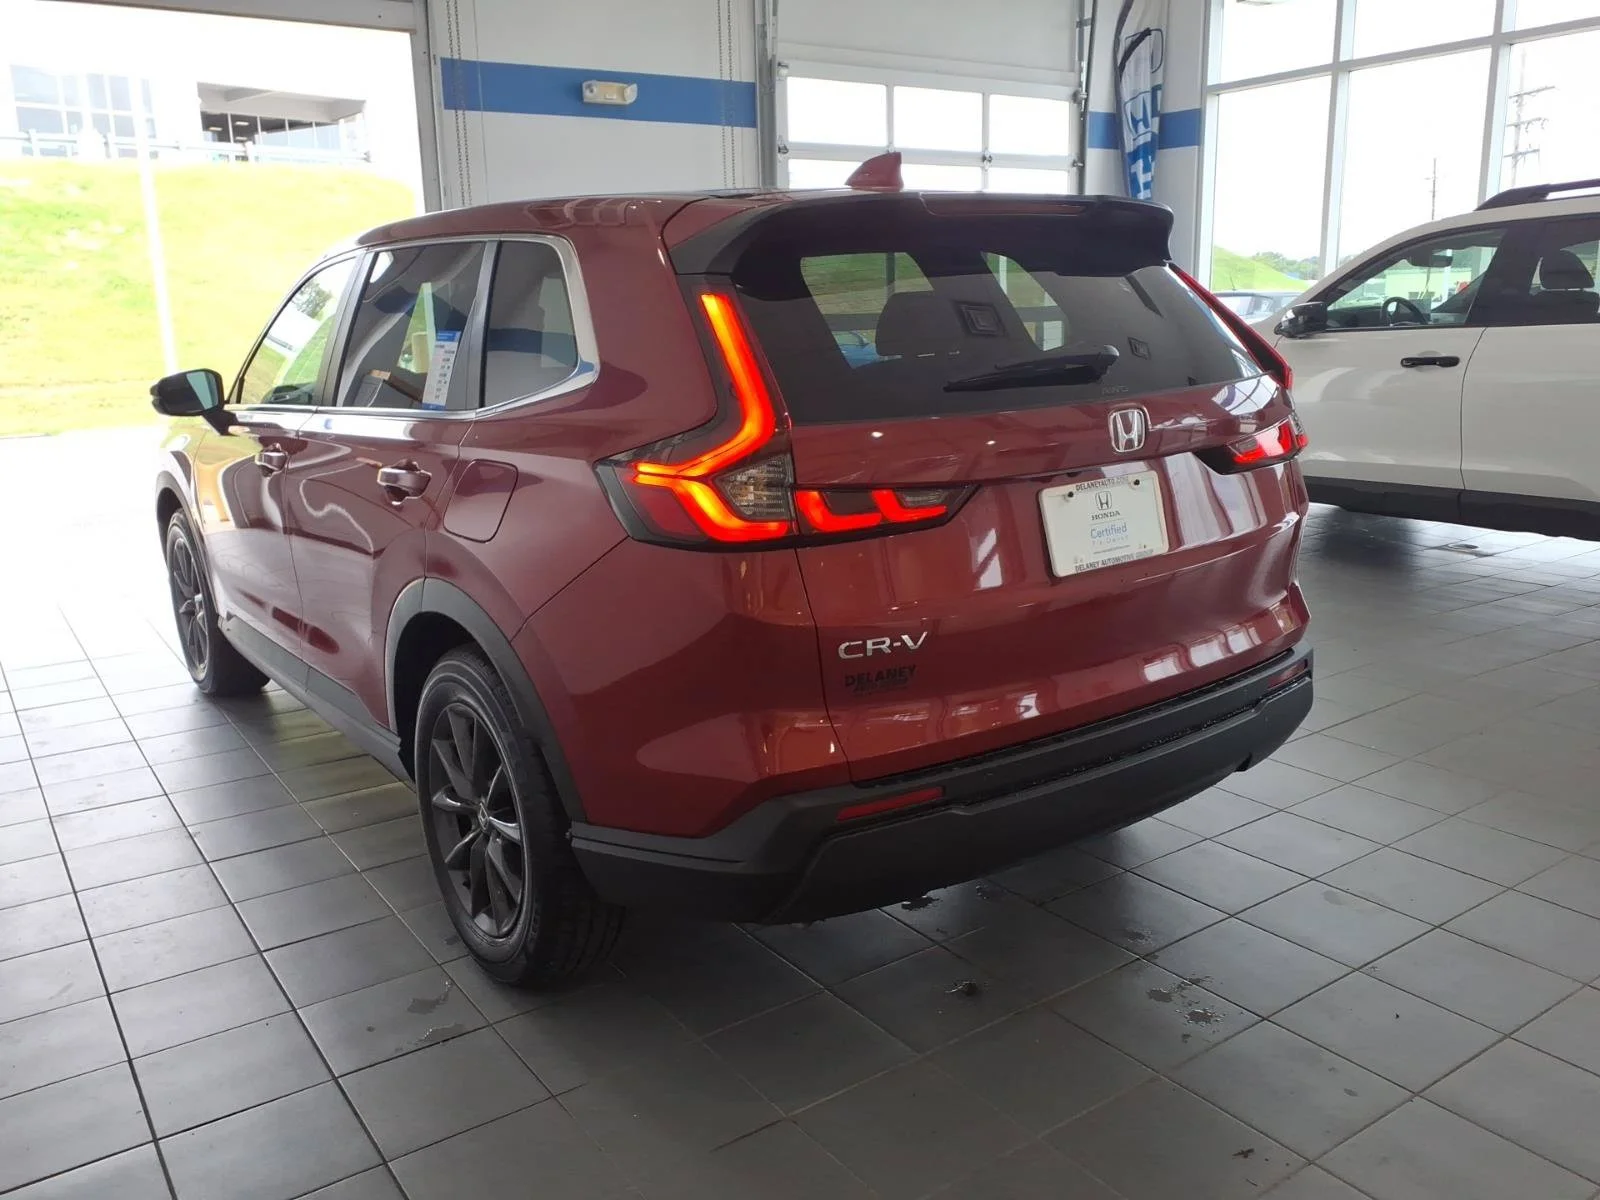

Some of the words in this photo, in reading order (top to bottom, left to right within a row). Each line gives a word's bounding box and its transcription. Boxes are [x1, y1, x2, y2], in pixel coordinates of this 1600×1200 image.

[1091, 510, 1120, 520] HONDA
[1090, 522, 1127, 539] Certified
[1075, 561, 1099, 572] DELANEY
[838, 631, 928, 659] CR-V
[844, 664, 917, 687] DELANEY
